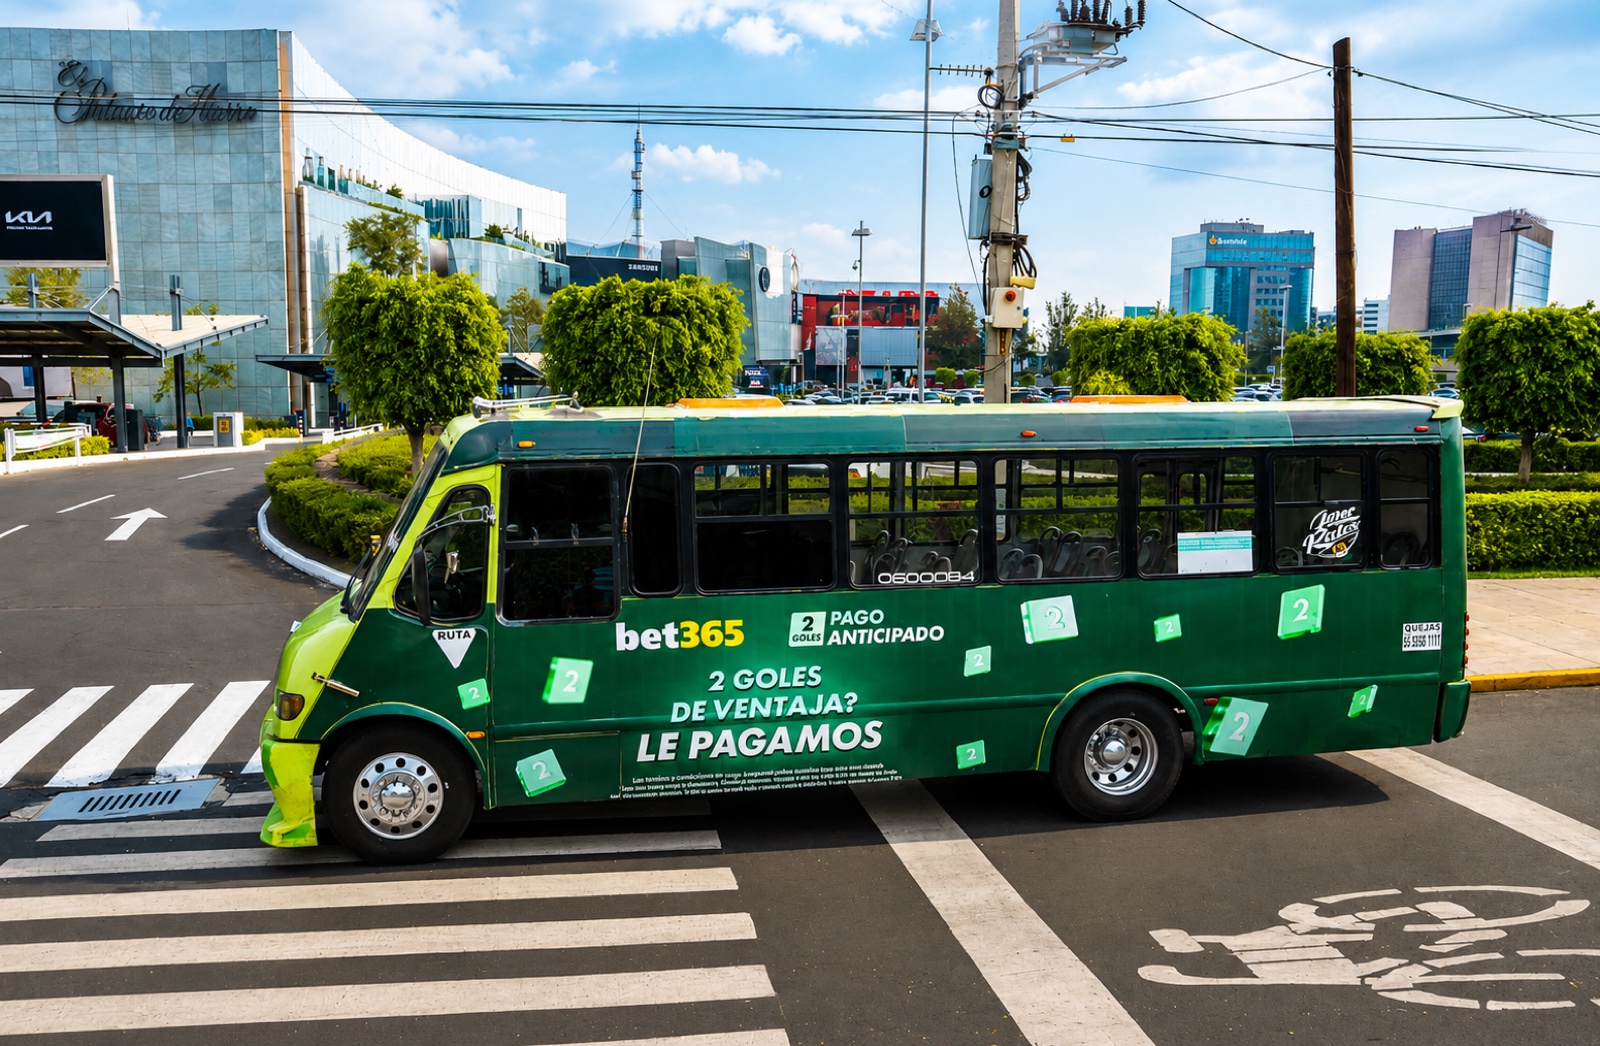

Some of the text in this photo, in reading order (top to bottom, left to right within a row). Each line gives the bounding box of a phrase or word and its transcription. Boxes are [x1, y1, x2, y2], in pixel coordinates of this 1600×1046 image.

[5, 210, 52, 224] KIA
[877, 571, 975, 584] 0600084
[830, 609, 884, 626] PAGO
[1293, 597, 1309, 623] 2
[802, 616, 814, 632] 2
[1045, 606, 1065, 631] 2
[437, 629, 472, 641] RUTA
[615, 619, 745, 651] bet365
[826, 625, 945, 646] ANTICIPADO
[1165, 622, 1174, 633] 2
[1404, 623, 1440, 632] QUEJAS
[792, 633, 821, 642] GOLES
[973, 654, 984, 667] 2
[562, 670, 579, 693] 2
[708, 665, 822, 692] 2 GOLES
[468, 687, 480, 700] 2
[1359, 694, 1367, 705] 2
[670, 692, 859, 723] DE VENTAJA?
[1228, 711, 1250, 742] 2
[636, 720, 884, 763] LE PAGAMOS
[966, 748, 977, 761] 2
[532, 761, 552, 781] 2
